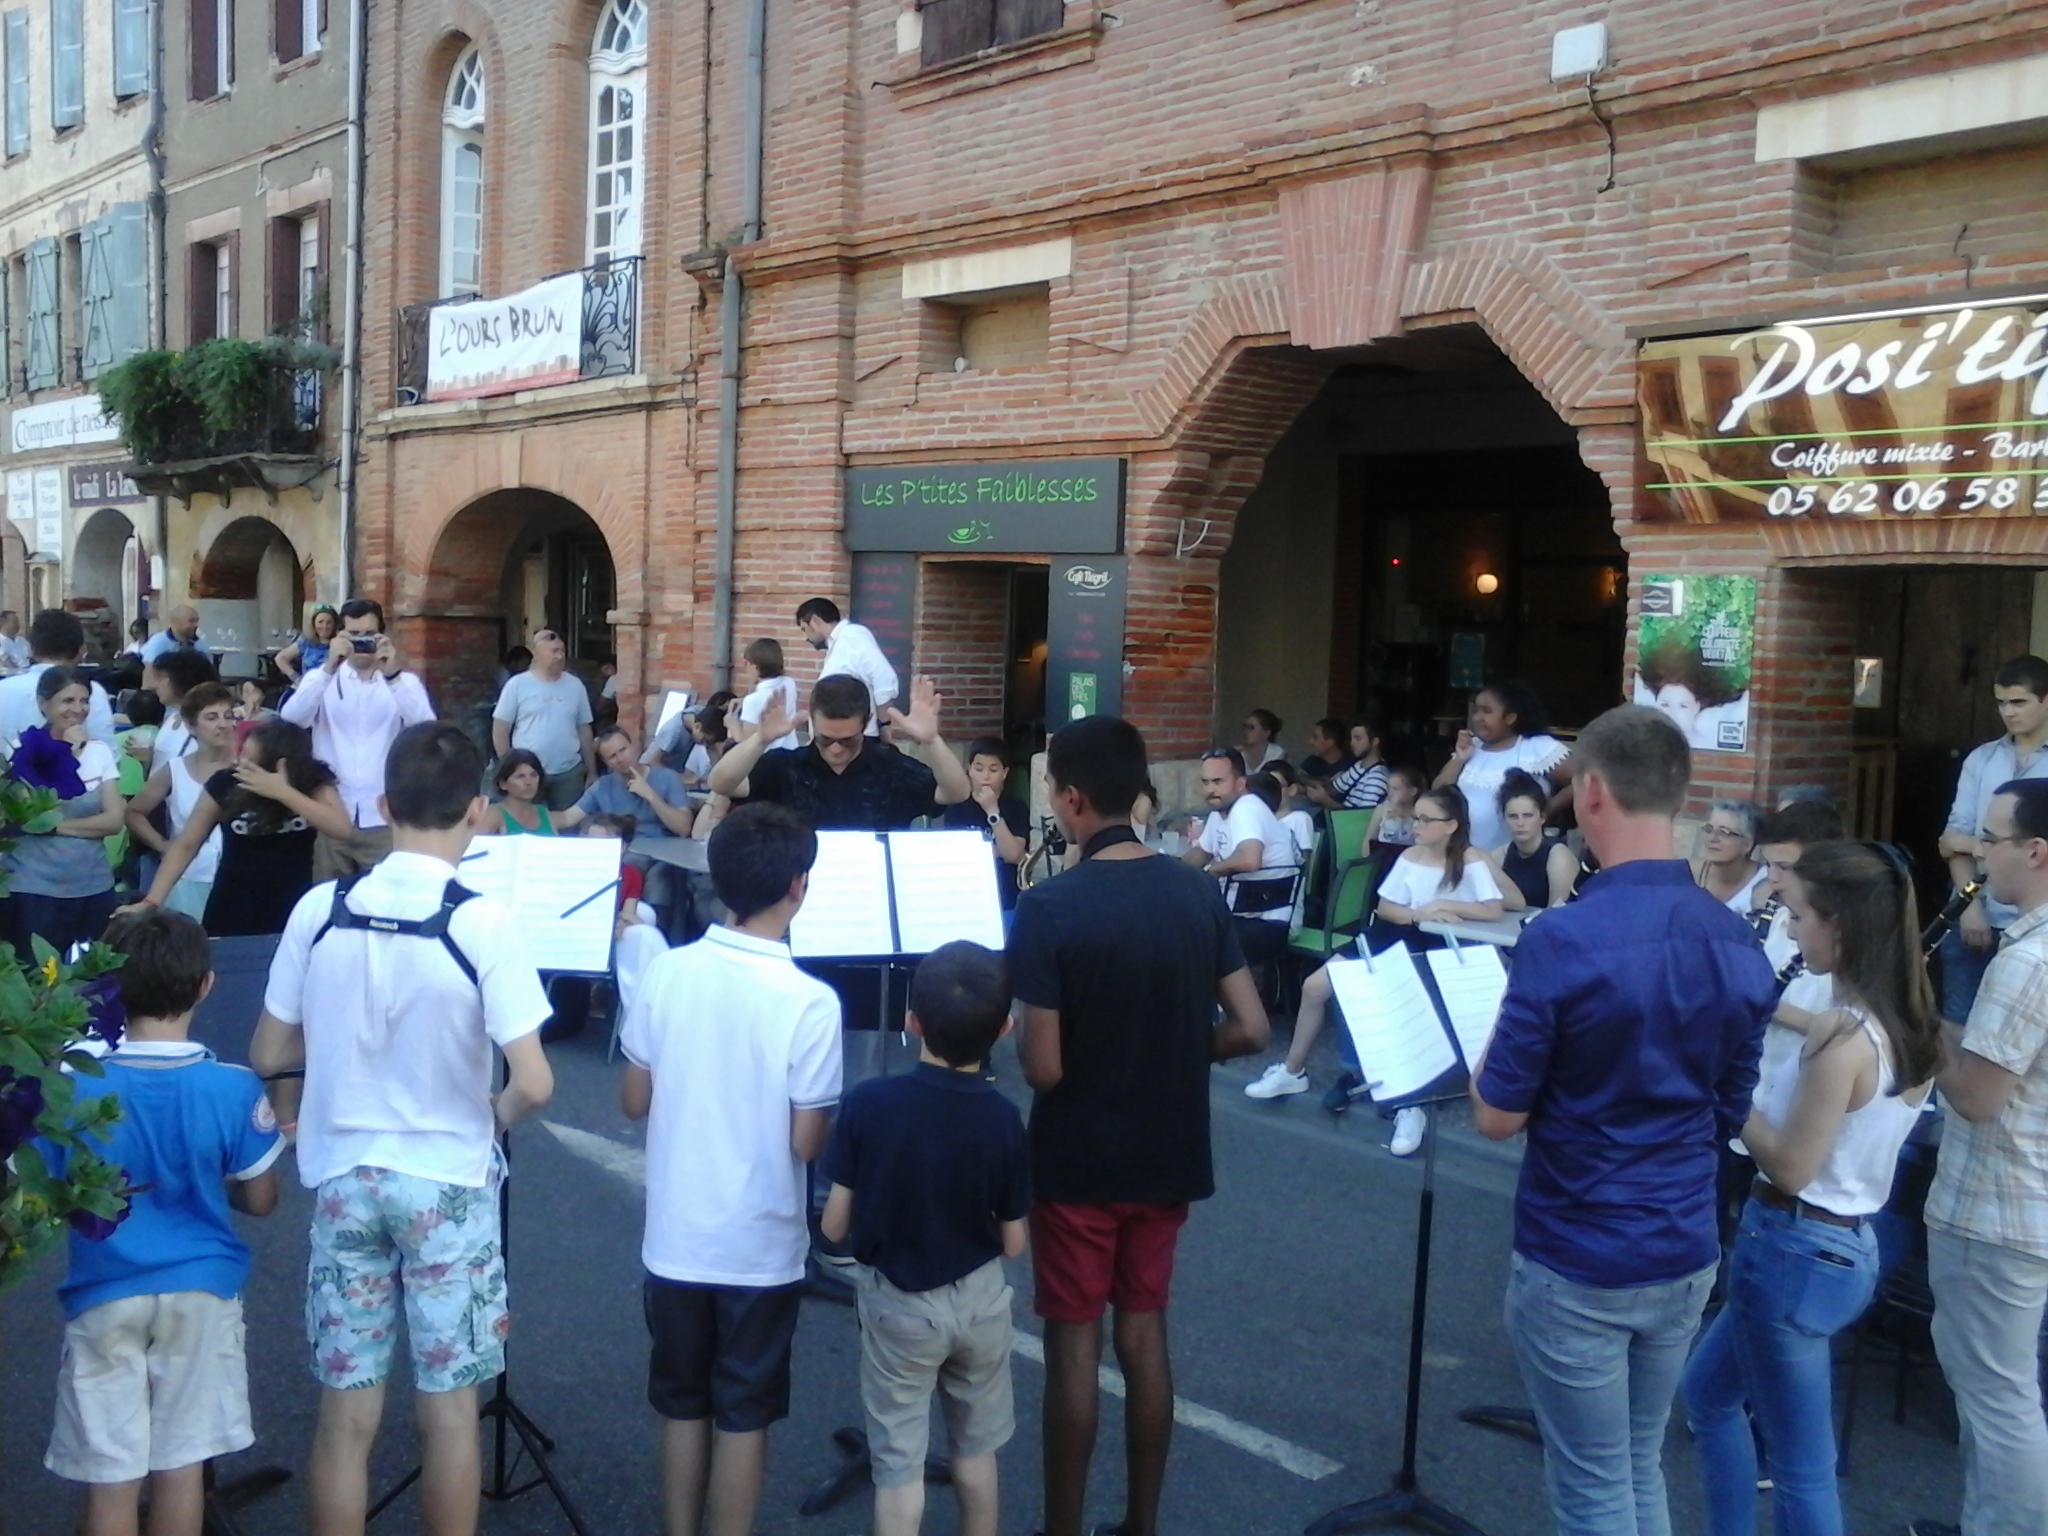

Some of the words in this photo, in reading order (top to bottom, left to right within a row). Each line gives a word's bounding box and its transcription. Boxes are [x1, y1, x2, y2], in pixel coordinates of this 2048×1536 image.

[508, 304, 564, 343] BRUN
[1717, 308, 2048, 432] Posi'ti
[1770, 443, 1878, 476] Coiffure
[1881, 441, 1955, 466] mixte
[861, 482, 894, 506] Les
[902, 475, 967, 504] P'tites
[977, 472, 1098, 503] Faiblesses
[1766, 484, 1816, 516] 05
[1827, 483, 1878, 514] 62
[1892, 478, 1949, 512] 06
[1958, 477, 2018, 510] 58
